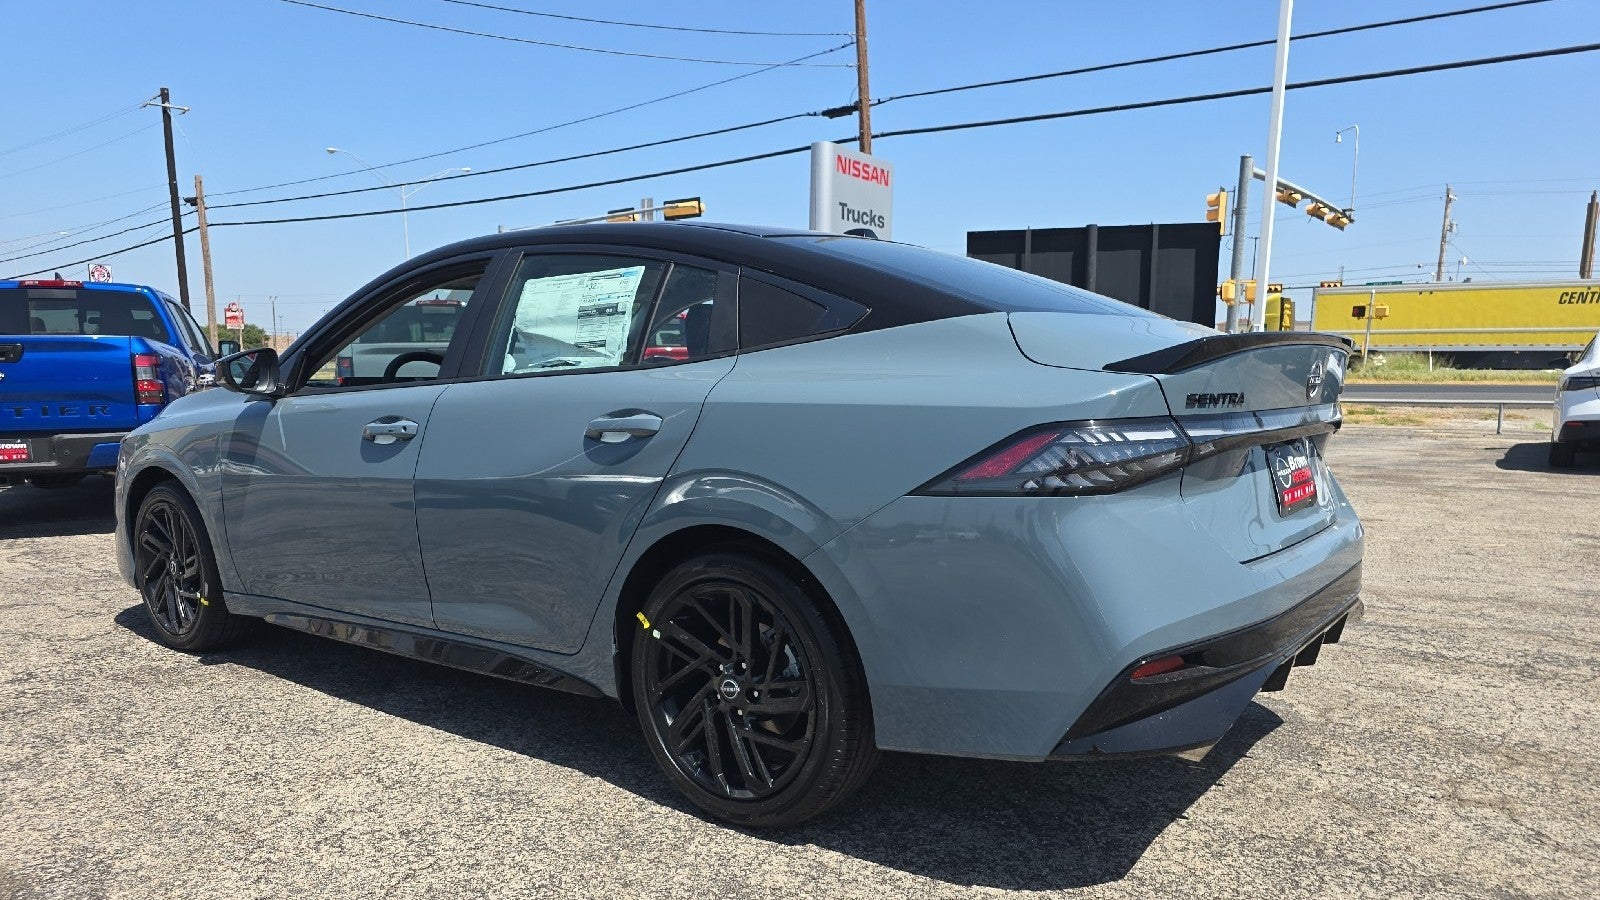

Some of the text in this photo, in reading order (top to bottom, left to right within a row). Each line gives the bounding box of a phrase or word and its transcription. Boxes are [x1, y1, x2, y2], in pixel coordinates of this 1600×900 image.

[836, 155, 889, 187] NISSAN
[839, 202, 885, 229] Trucks
[1185, 392, 1245, 409] SENTRA
